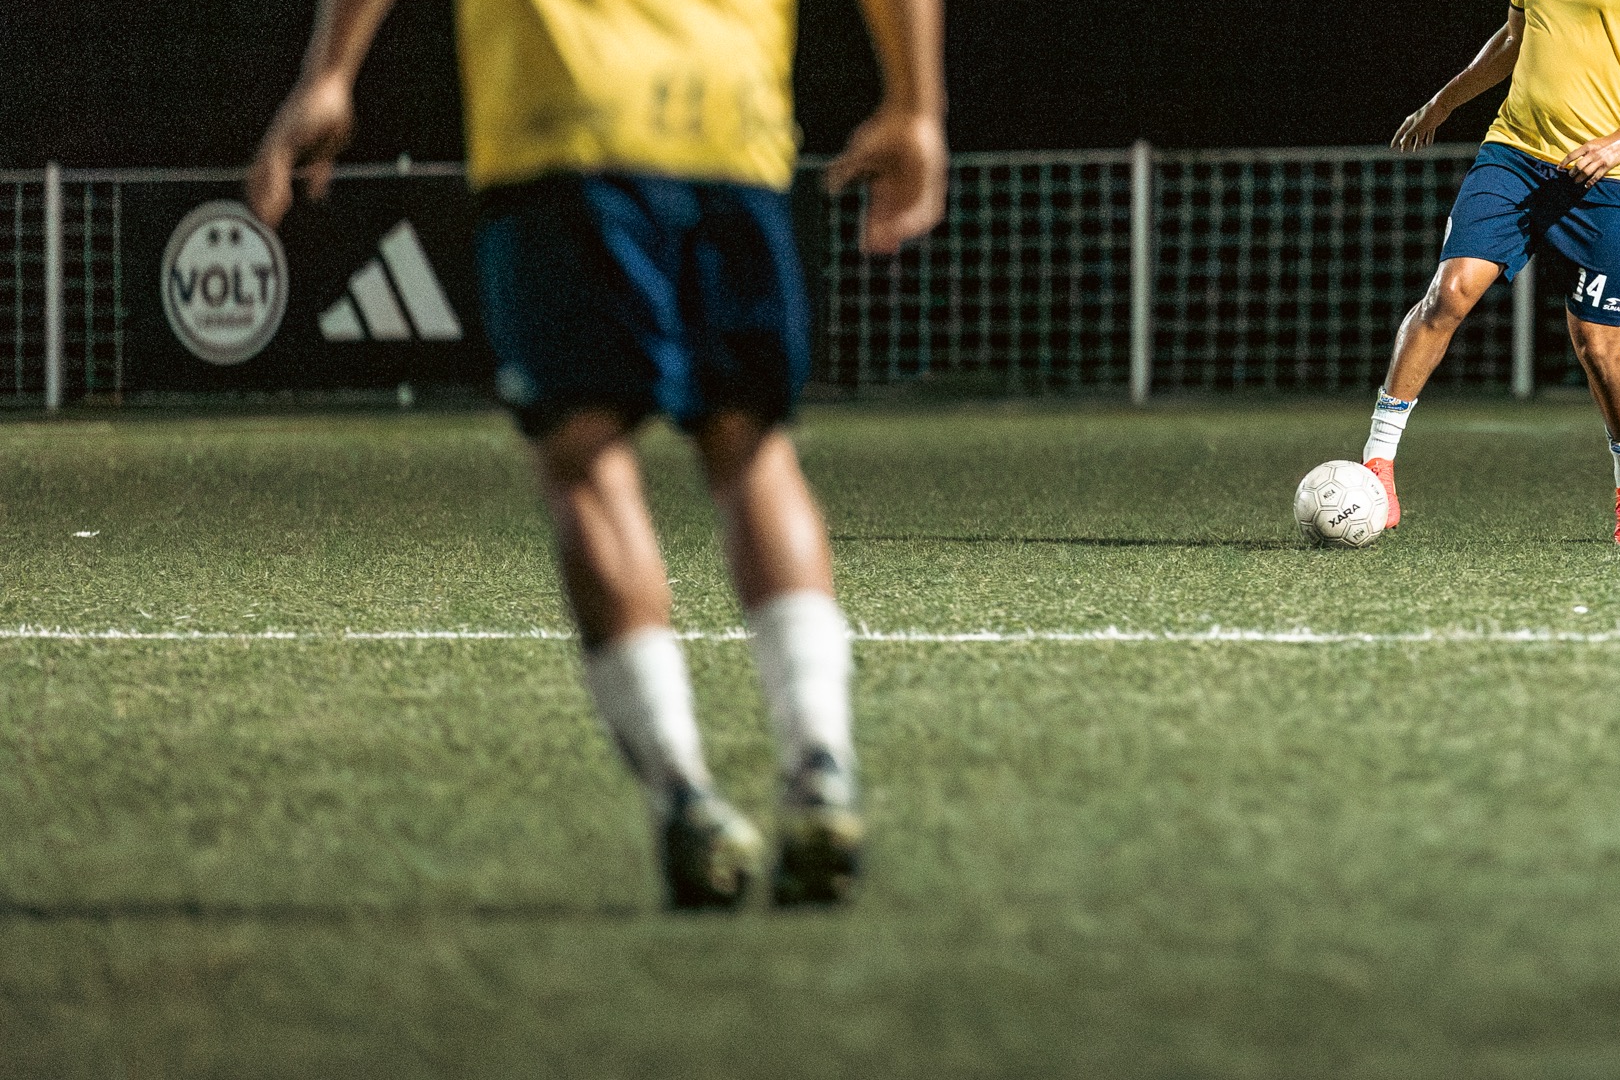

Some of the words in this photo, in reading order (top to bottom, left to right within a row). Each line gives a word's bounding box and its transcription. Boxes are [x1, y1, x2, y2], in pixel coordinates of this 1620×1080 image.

[172, 264, 276, 307] VOLT
[1572, 267, 1607, 308] 14
[1328, 503, 1361, 528] XARA
